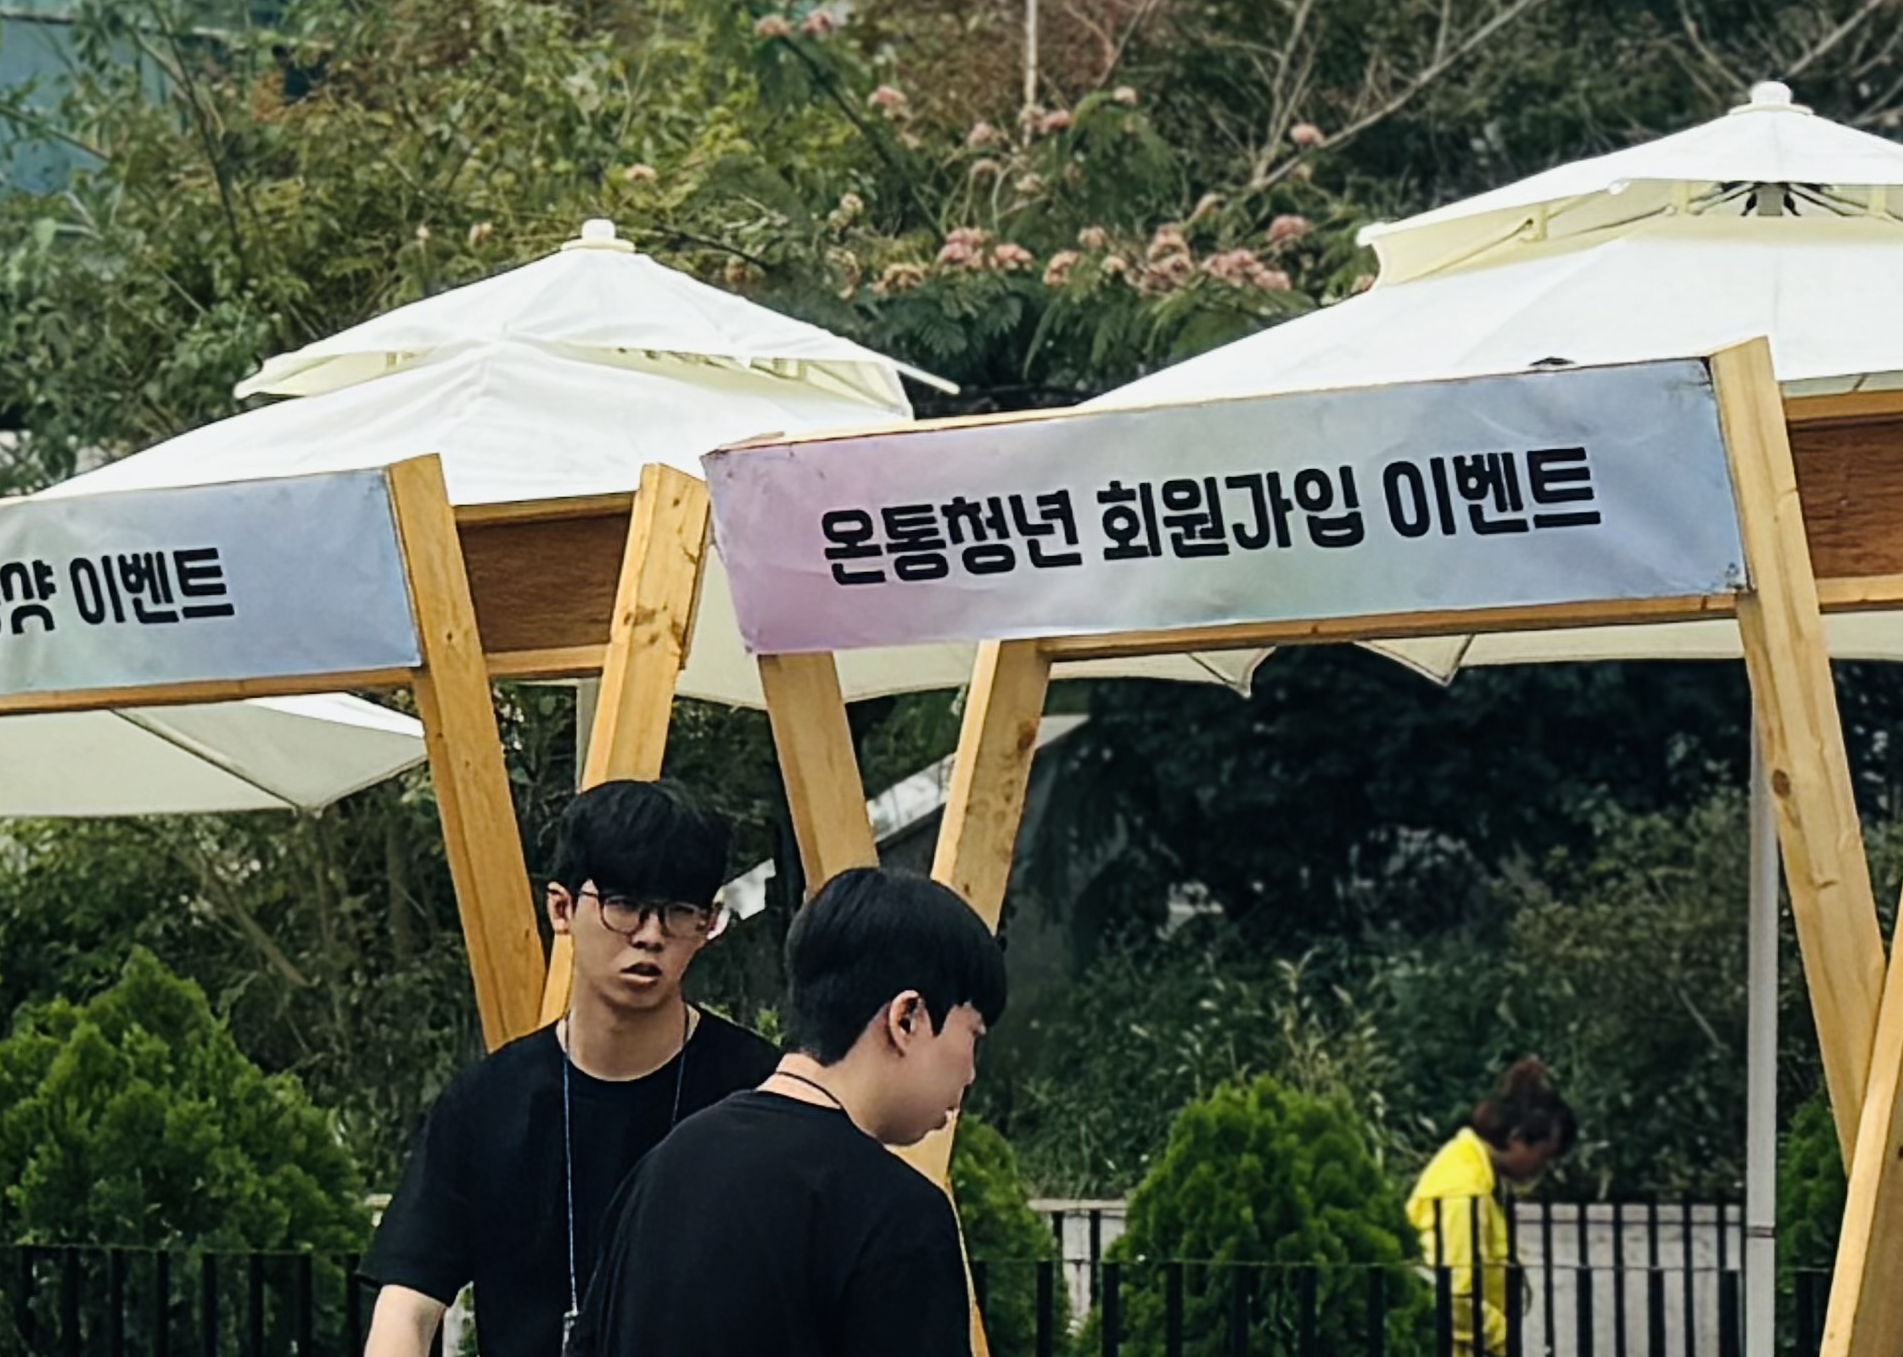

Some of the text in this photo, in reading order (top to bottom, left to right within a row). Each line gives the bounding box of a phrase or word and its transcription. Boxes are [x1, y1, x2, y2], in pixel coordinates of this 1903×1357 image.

[820, 446, 1602, 586] 온통청년 회원가입 이벤트
[71, 546, 235, 626] 이벤트
